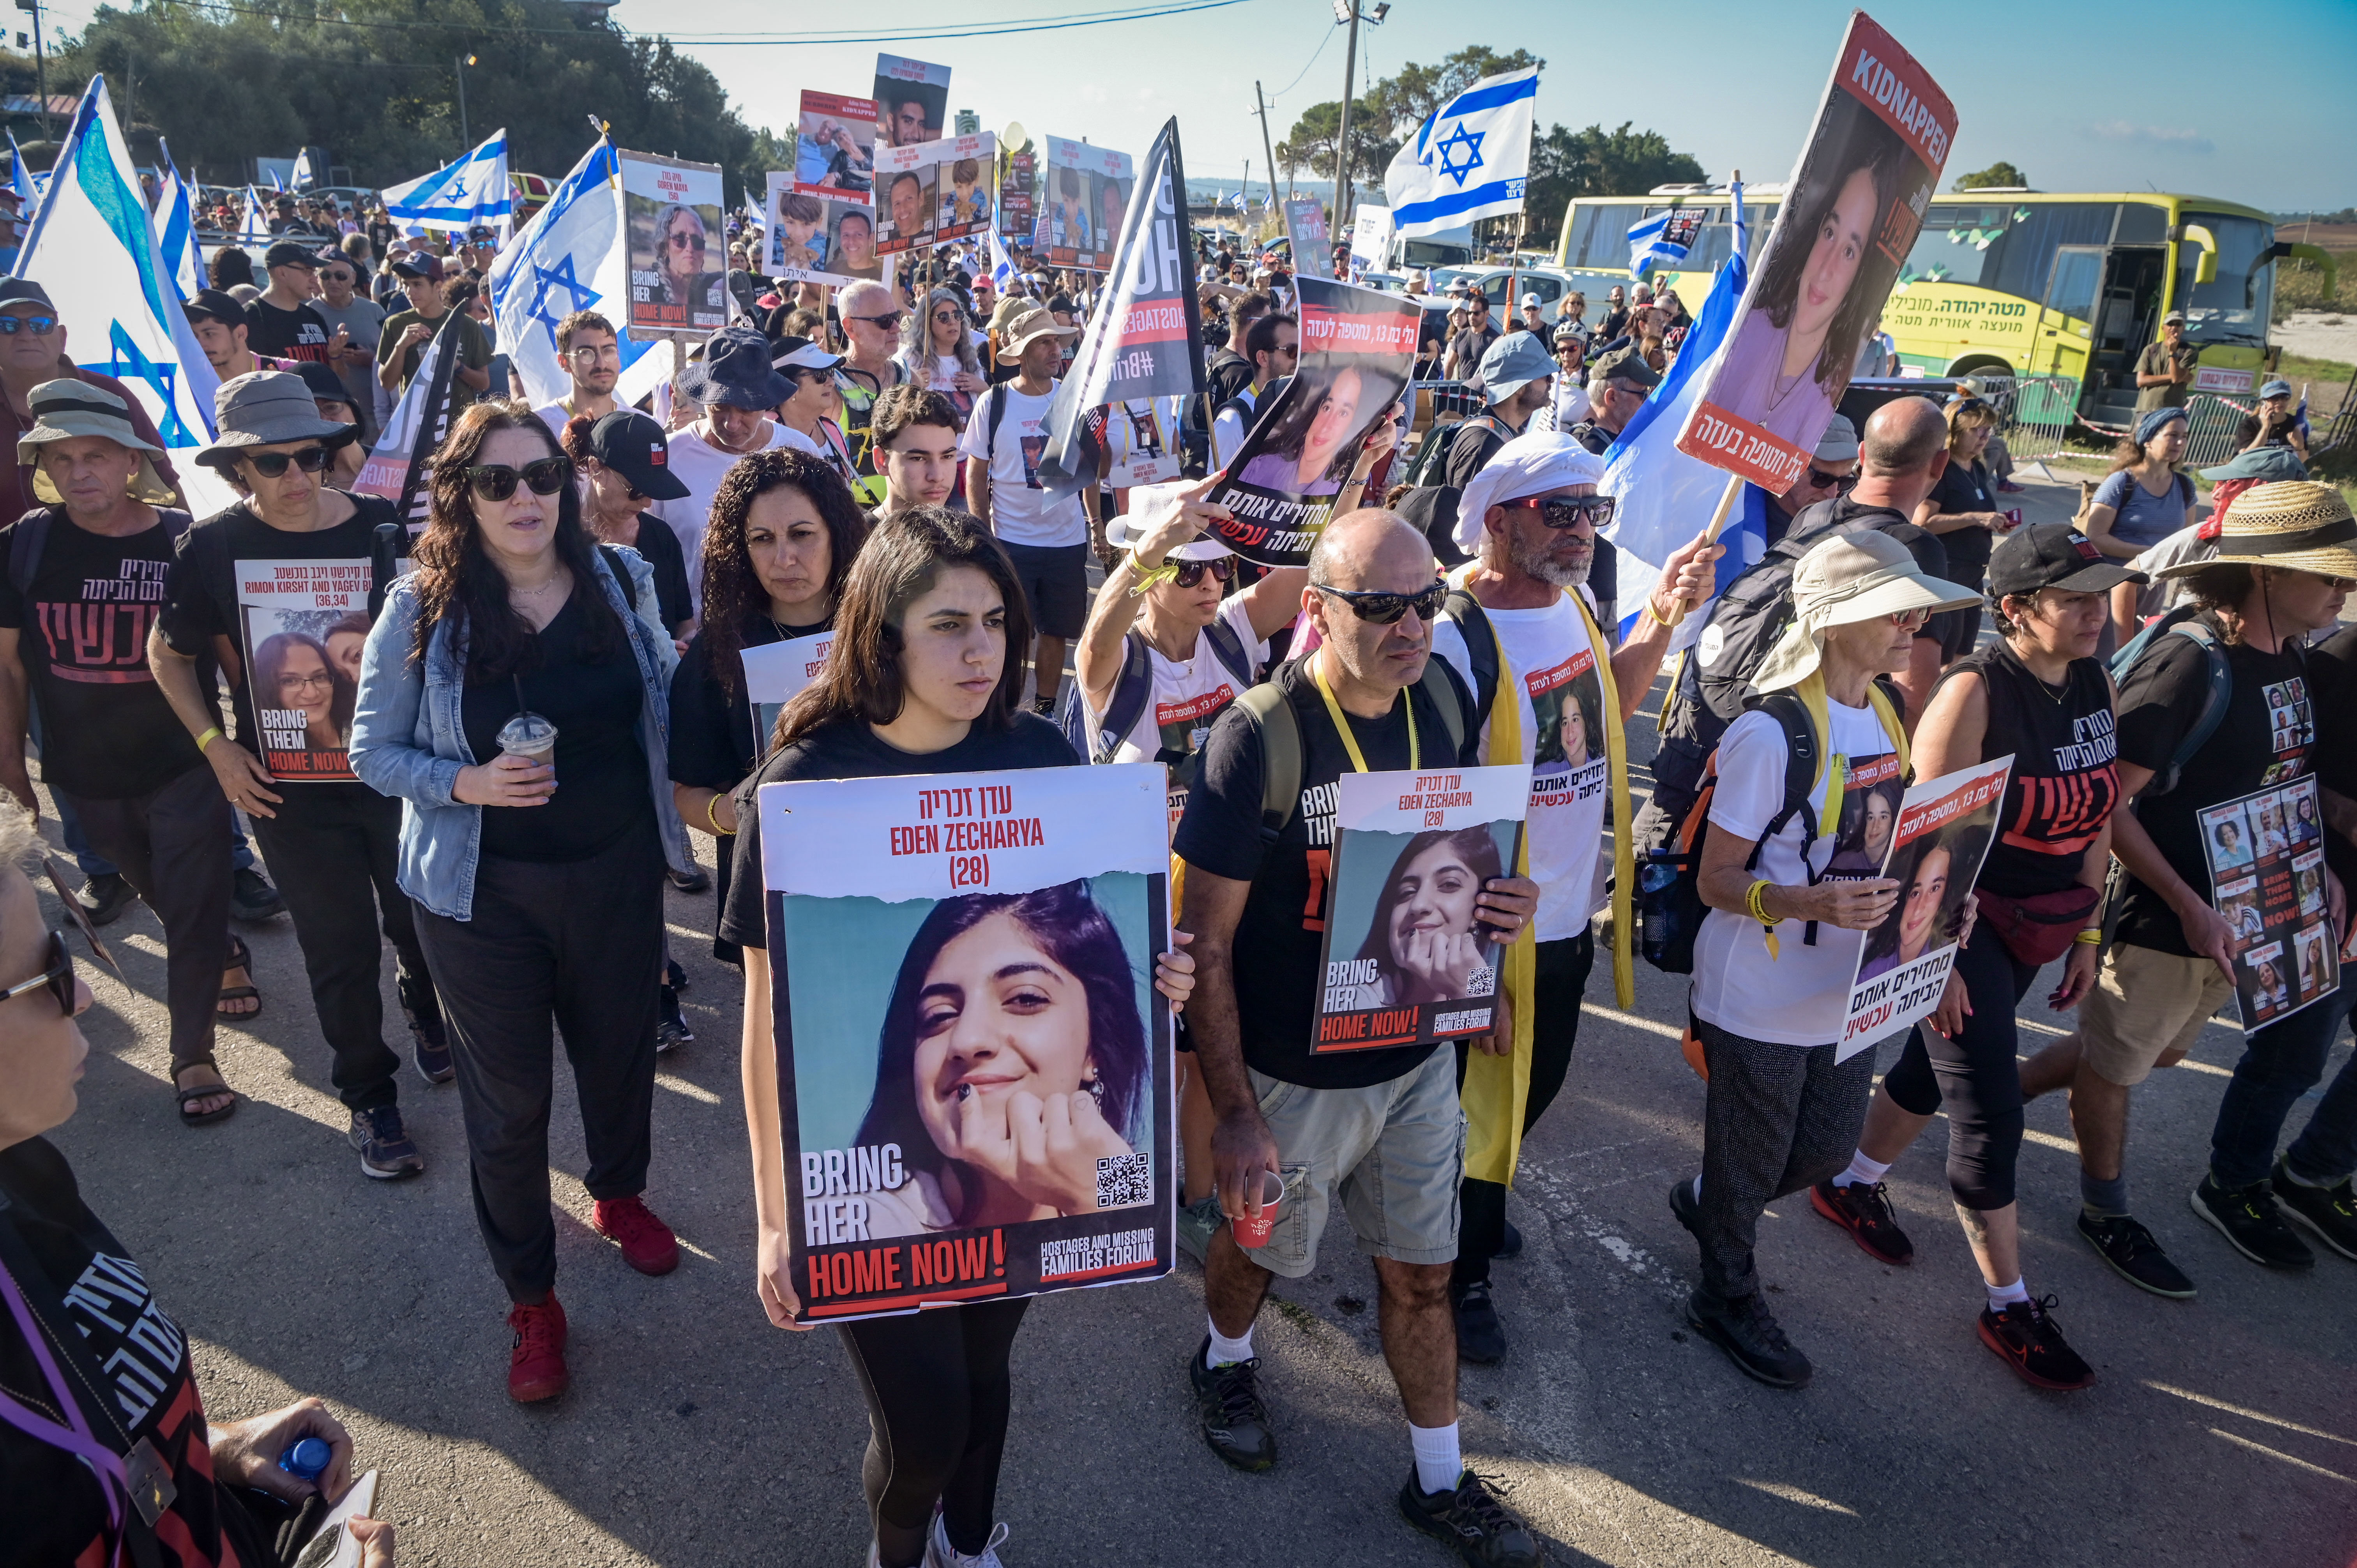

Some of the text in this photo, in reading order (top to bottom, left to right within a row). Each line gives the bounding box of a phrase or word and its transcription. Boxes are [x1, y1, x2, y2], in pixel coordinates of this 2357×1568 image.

[843, 106, 876, 117] KIDNAPPED
[1852, 48, 1947, 166] KIDNAPPED
[658, 180, 688, 192] GOREN MAYA
[939, 207, 954, 219] BRING
[878, 220, 894, 232] BRING
[938, 218, 949, 229] HIM
[1051, 221, 1064, 234] BRING
[877, 232, 888, 242] HIM
[937, 228, 952, 239] HOME
[877, 240, 892, 253] HOME
[893, 237, 910, 249] NOW!
[632, 270, 659, 287] BRING
[783, 268, 807, 279] איתן
[633, 286, 650, 302] HER
[634, 304, 687, 321] HOME NOW!
[1988, 302, 2026, 316] מטה
[694, 317, 710, 325] FAMILIES
[1307, 318, 1336, 338] לעזה
[1895, 315, 2023, 332] מועצה אזורית מטה
[1337, 322, 1371, 341] נחטפה
[1387, 327, 1401, 343] בת
[1402, 325, 1415, 344] גלי
[1695, 414, 1744, 455] בעזה
[1740, 435, 1787, 475] חטופה
[1144, 469, 1157, 477] NEUTRA
[1219, 488, 1331, 525] מחזירים אותם
[1265, 530, 1318, 552] הביתה
[120, 559, 170, 581] חזירים
[274, 567, 308, 579] בוכשטב
[311, 567, 328, 579] ויגב
[331, 567, 360, 580] קירשט
[82, 579, 136, 600] הביתה
[245, 581, 274, 593] RIMON
[277, 581, 309, 593] KIRSHT
[312, 581, 330, 592] AND
[332, 580, 360, 592] YAGEV
[315, 593, 348, 608] (36,34)
[1579, 657, 1586, 669] בת
[1551, 666, 1571, 683] נחטפה
[1531, 675, 1550, 692] לעזה
[1211, 695, 1220, 707] בת
[1219, 688, 1232, 697] גלי
[261, 709, 307, 729] BRING
[1159, 709, 1175, 720] לעזה
[1175, 705, 1197, 718] נחטפה
[263, 730, 306, 749] THEM
[268, 752, 310, 771] HOME
[2053, 741, 2094, 772] הביתה
[1857, 767, 1877, 781] נחטפה
[1415, 775, 1461, 792] עדן זכריה
[1533, 775, 1568, 792] אותם
[1990, 777, 2003, 794] גלי
[1398, 791, 1472, 811] EDEN ZECHARYA
[1530, 789, 1574, 807] עכשיו!
[1974, 784, 1989, 803] בת
[919, 785, 1012, 821] עדן זכריה
[1926, 798, 1959, 825] נחטפה
[1424, 811, 1444, 828] (28)
[1900, 811, 1927, 838] לעזה
[890, 818, 1044, 856] EDEN ZECHARYA
[949, 854, 989, 889] (28)
[2263, 870, 2290, 887] BRING
[2265, 881, 2291, 896] THEM
[2265, 891, 2293, 908] HOME
[2264, 904, 2299, 928] NOW!
[1325, 958, 1378, 987] BRING
[1851, 952, 1951, 1015] מחזירים אותם
[1323, 986, 1356, 1014] HER
[1435, 1007, 1491, 1023] HOSTAGES AND MISSING
[1844, 977, 1944, 1042] הביתה עכשיו!
[1320, 1005, 1419, 1042] HOME NOW!
[1434, 1017, 1491, 1034] FAMILIES FORUM
[800, 1142, 903, 1197] BRING
[805, 1196, 870, 1247] HER
[1041, 1227, 1154, 1255] HOSTAGES AND MISSING
[807, 1228, 1007, 1299] HOME NOW!
[1041, 1241, 1155, 1276] FAMILIES FORUM
